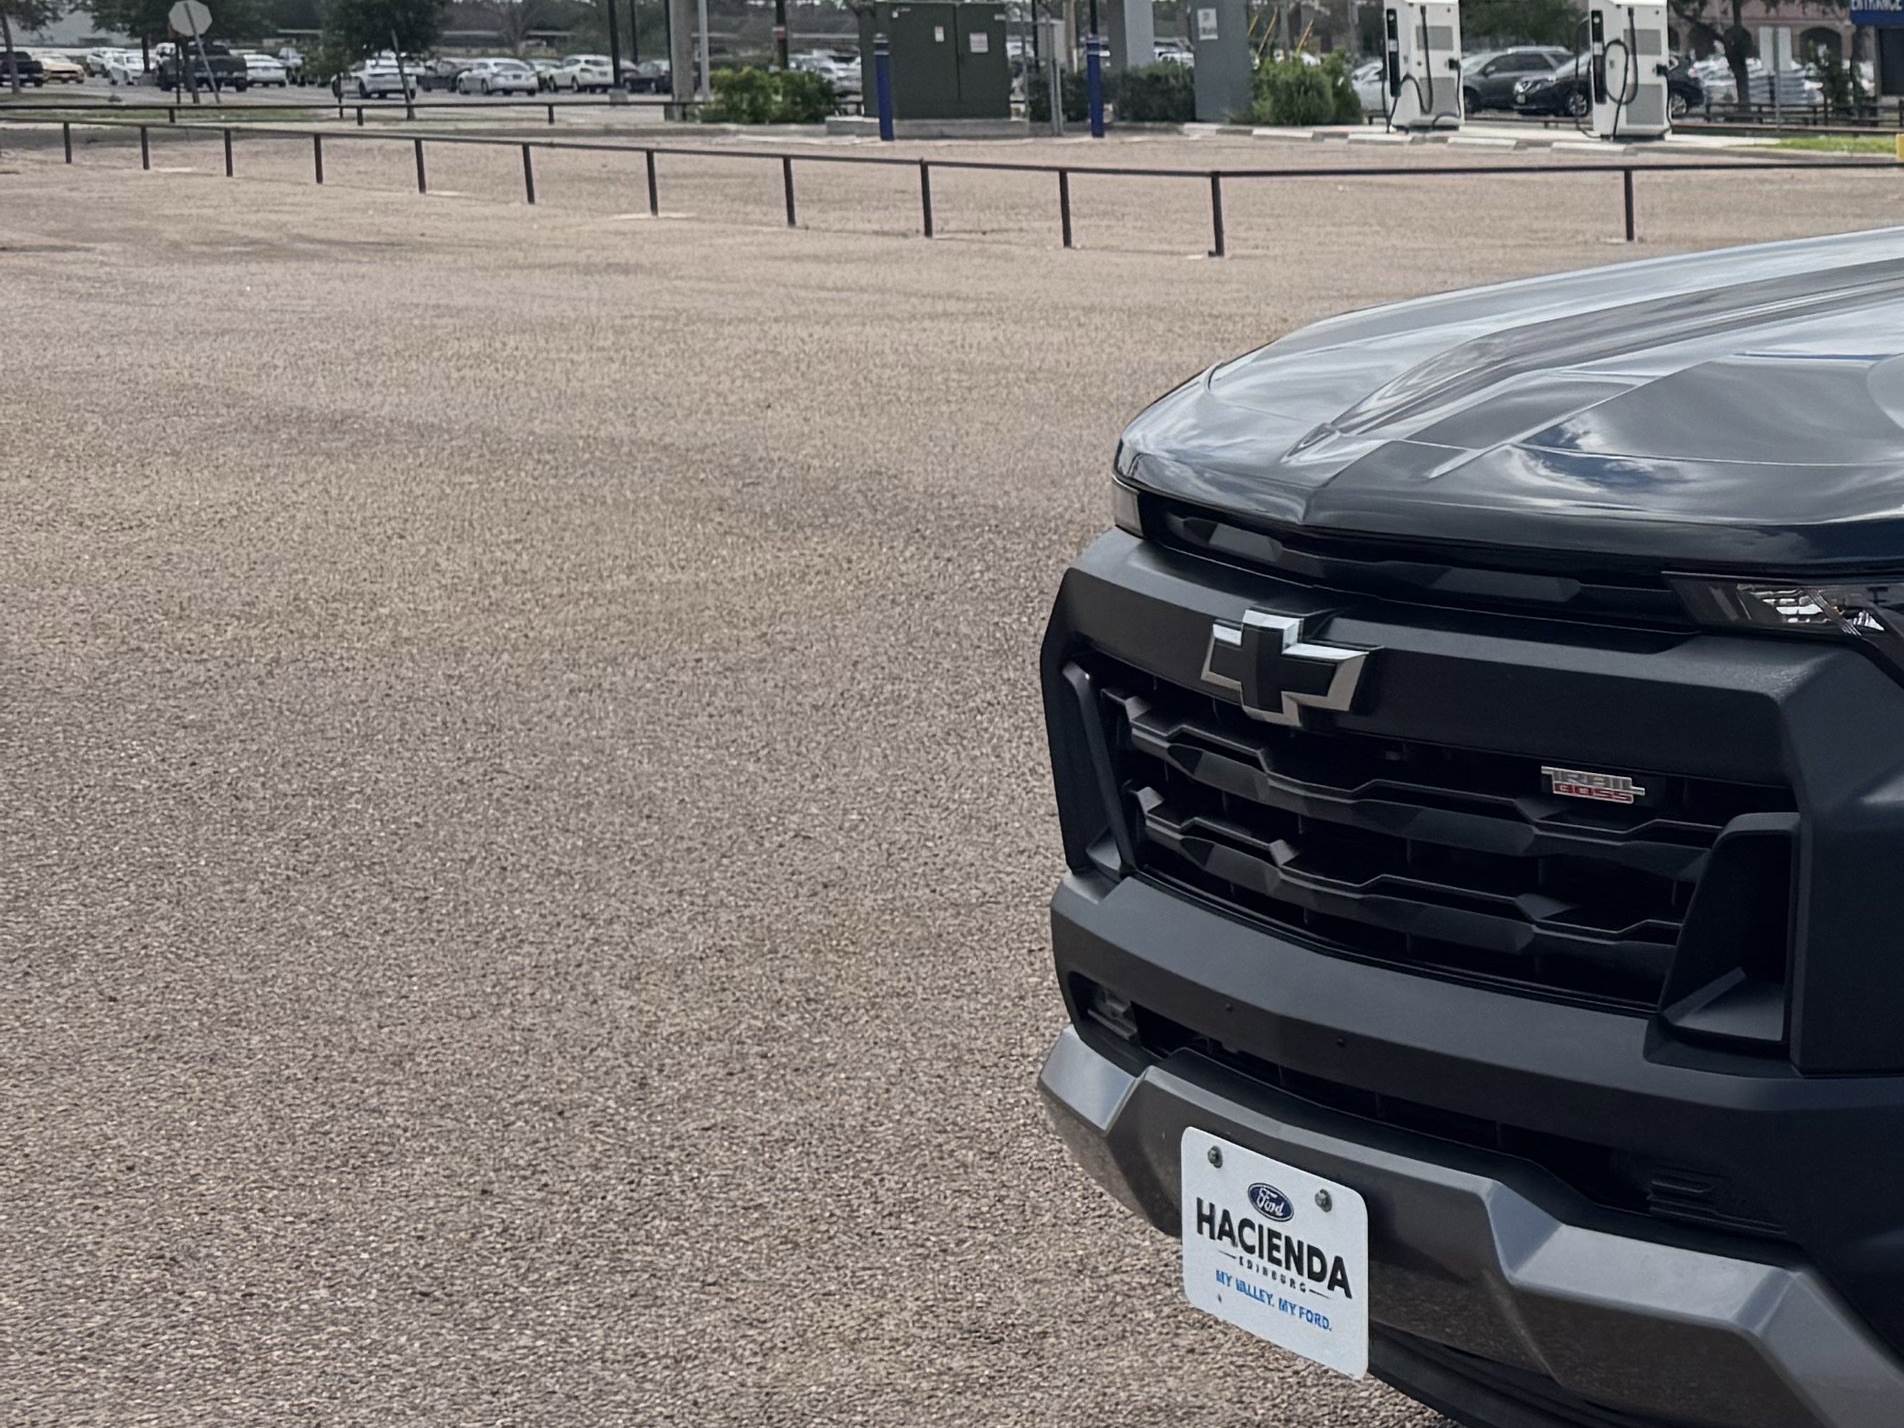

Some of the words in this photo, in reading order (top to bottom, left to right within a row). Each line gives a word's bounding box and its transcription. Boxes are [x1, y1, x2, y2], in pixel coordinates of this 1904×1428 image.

[1195, 1196, 1353, 1300] HACIENDA
[1215, 1269, 1233, 1288] MY
[1278, 1296, 1298, 1316] MY
[1238, 1256, 1307, 1293] EDINBURG
